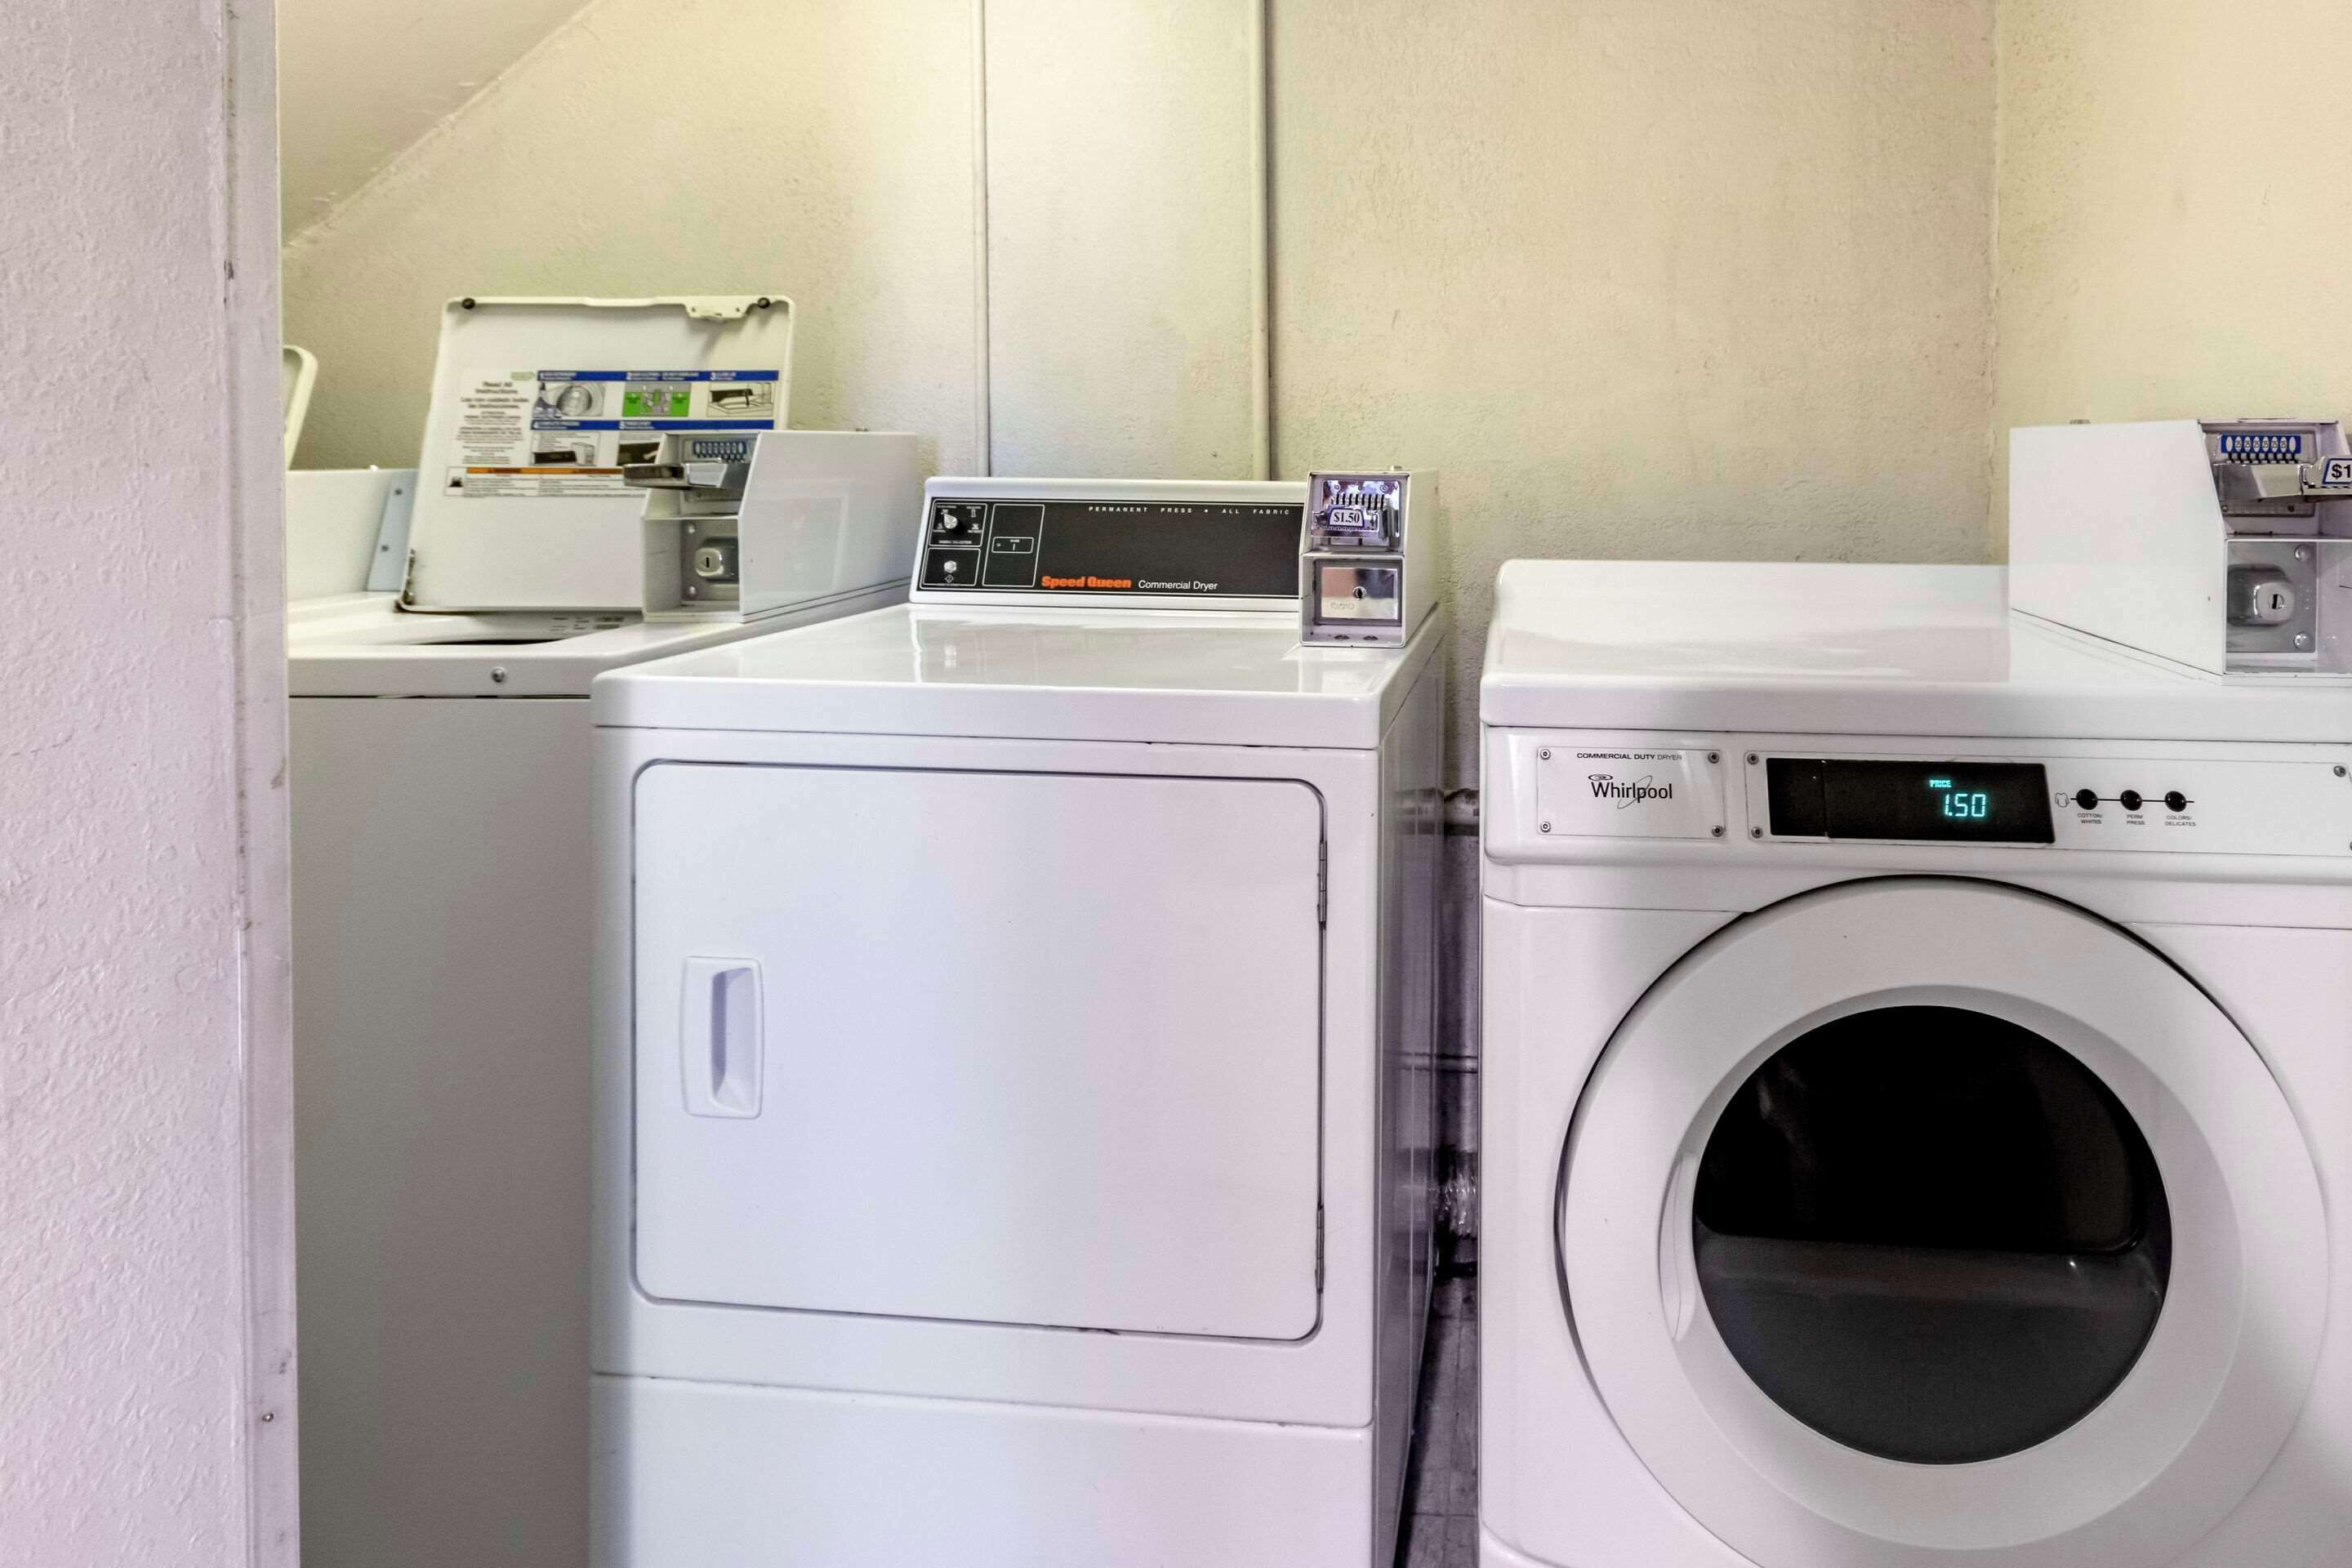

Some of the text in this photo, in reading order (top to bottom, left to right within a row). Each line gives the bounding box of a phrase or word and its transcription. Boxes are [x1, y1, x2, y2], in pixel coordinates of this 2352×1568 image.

[1334, 511, 1360, 524] $1.50
[1040, 576, 1218, 592] Speed Queen Commercial Dryer
[1929, 779, 1952, 788] PRICE
[1591, 782, 1673, 804] Whirlpool
[1944, 793, 1986, 817] 1.50
